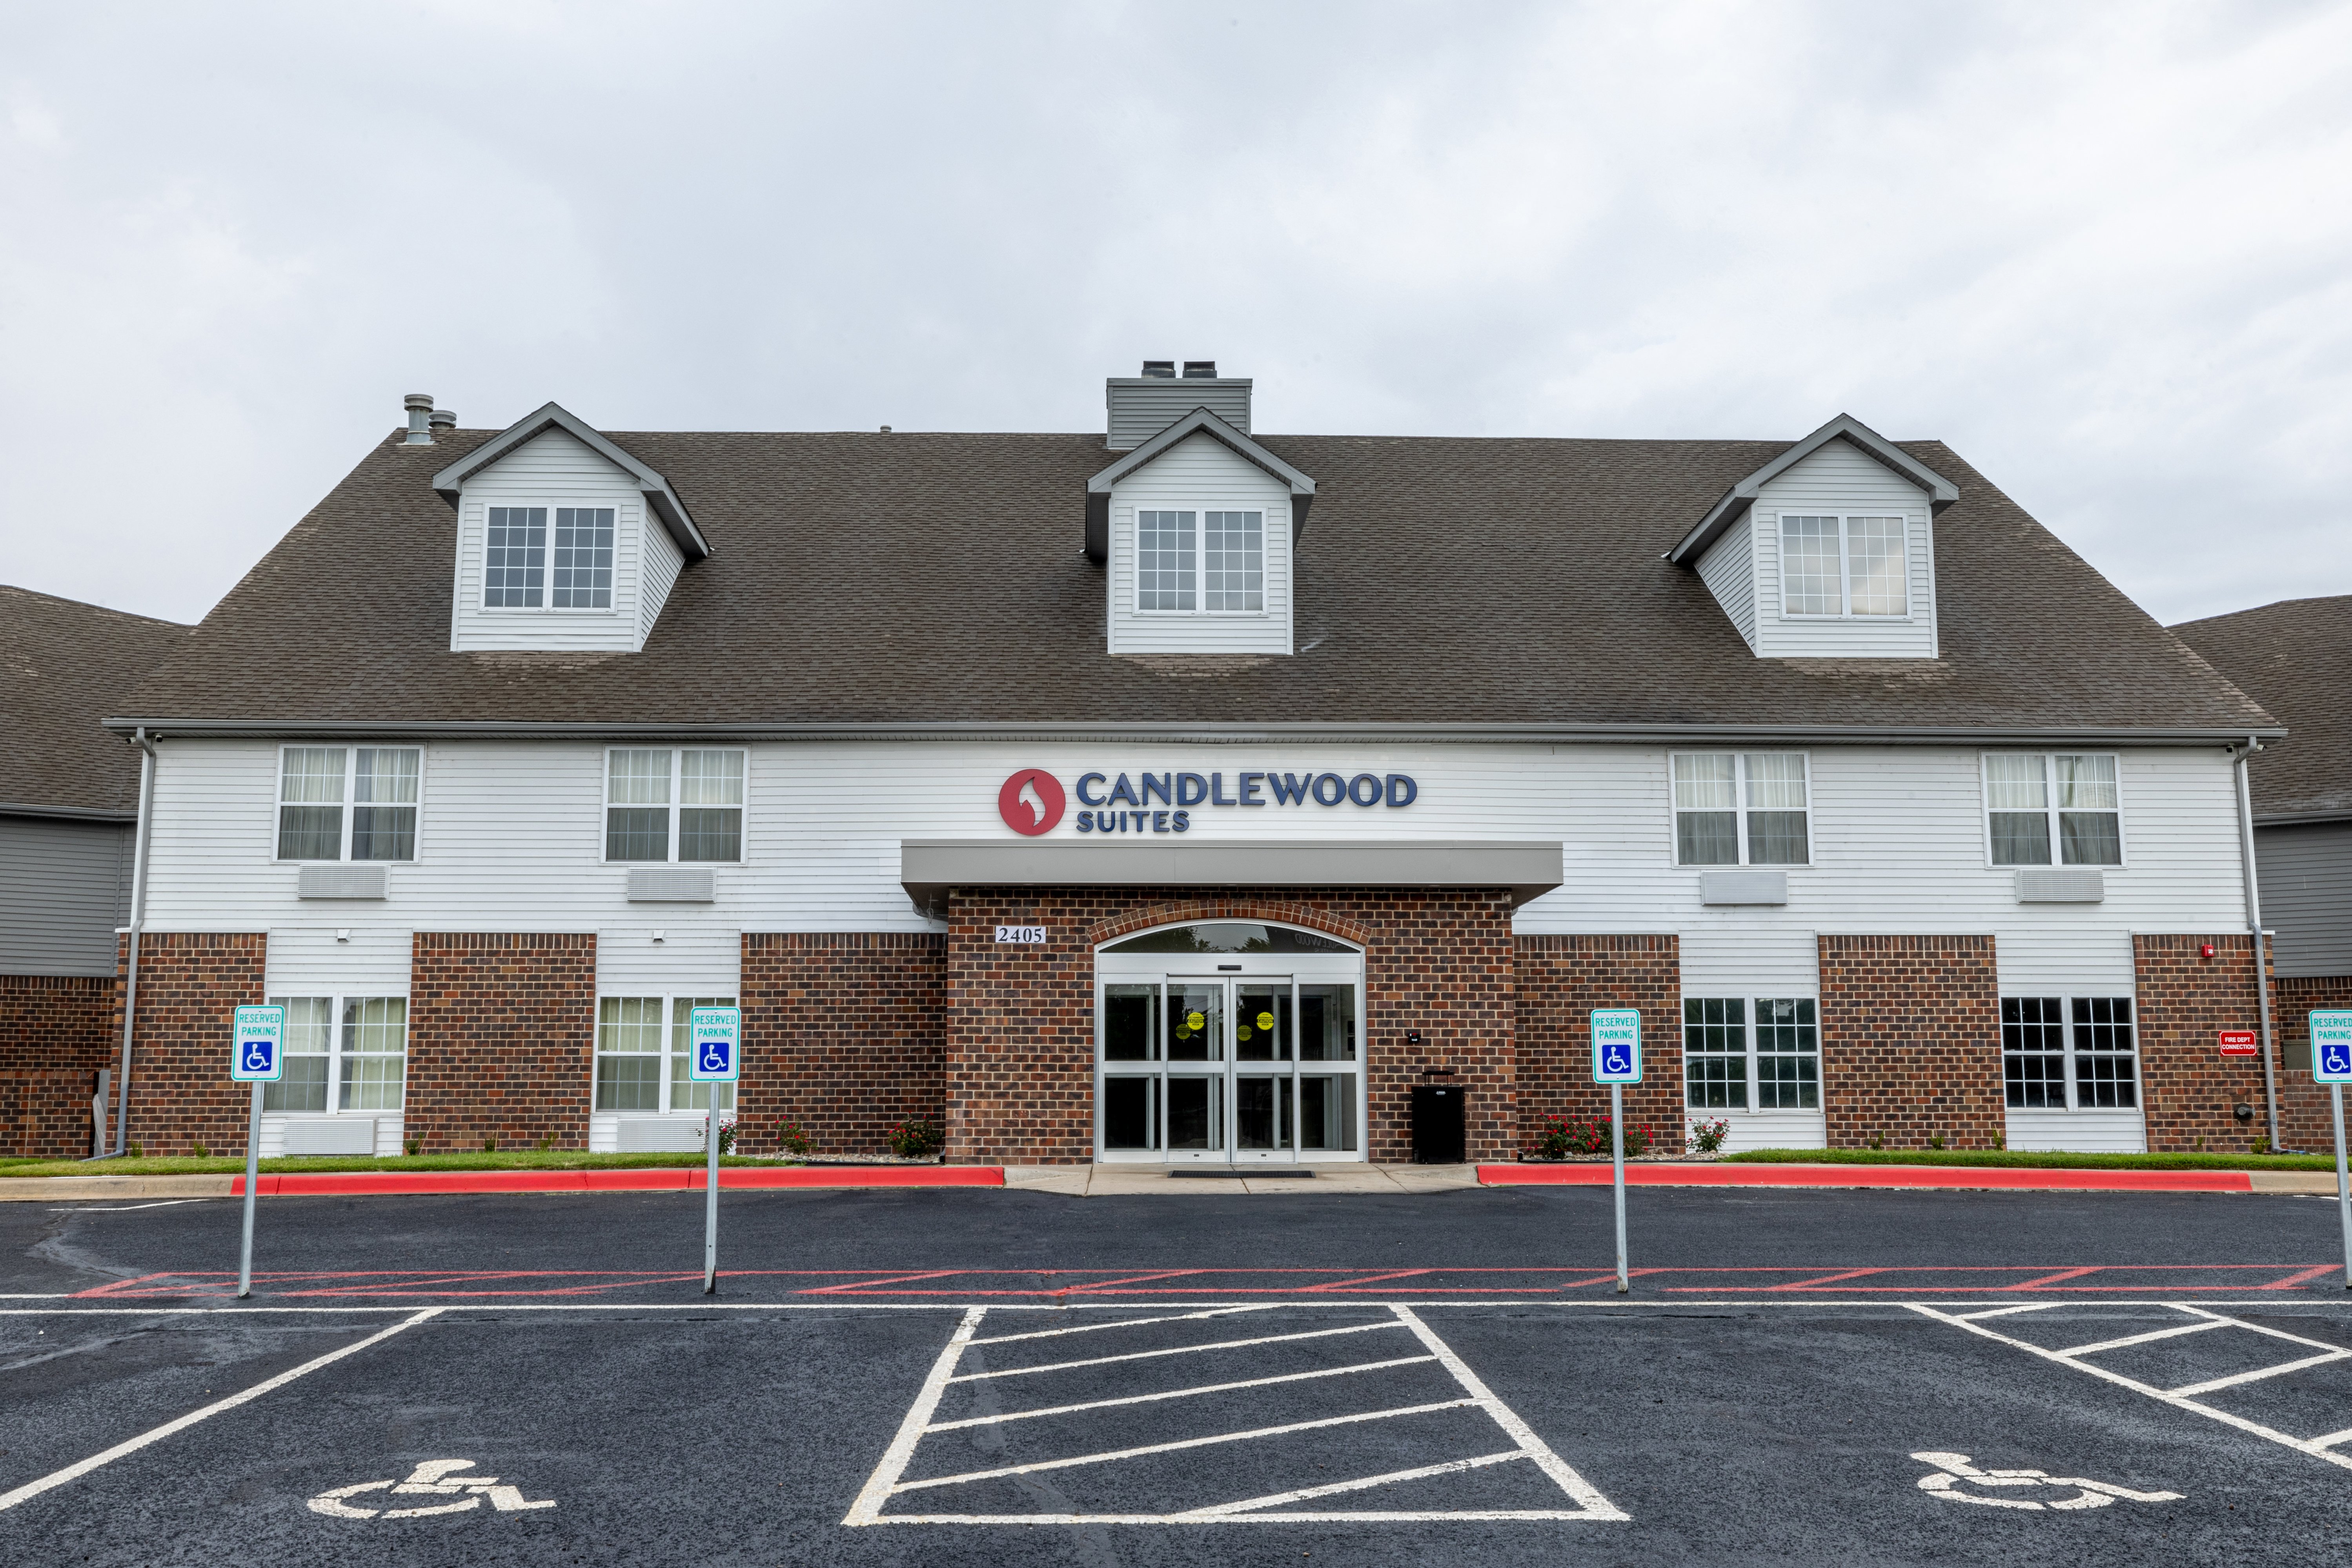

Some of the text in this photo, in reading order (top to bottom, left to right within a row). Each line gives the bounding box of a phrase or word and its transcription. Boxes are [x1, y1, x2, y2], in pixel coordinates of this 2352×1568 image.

[1076, 772, 1418, 807] CANDLEWOOD
[1076, 810, 1190, 832] SUITES
[998, 927, 1042, 942] 2405
[239, 1014, 280, 1023] RESERVED
[695, 1015, 736, 1024] RESERVED
[1596, 1018, 1636, 1027] RESERVED
[2314, 1018, 2352, 1027] RESERVED
[242, 1027, 276, 1036] PARKING
[698, 1028, 732, 1037] PARKING
[1599, 1030, 1633, 1039] PARKING
[2318, 1031, 2351, 1040] PARKING
